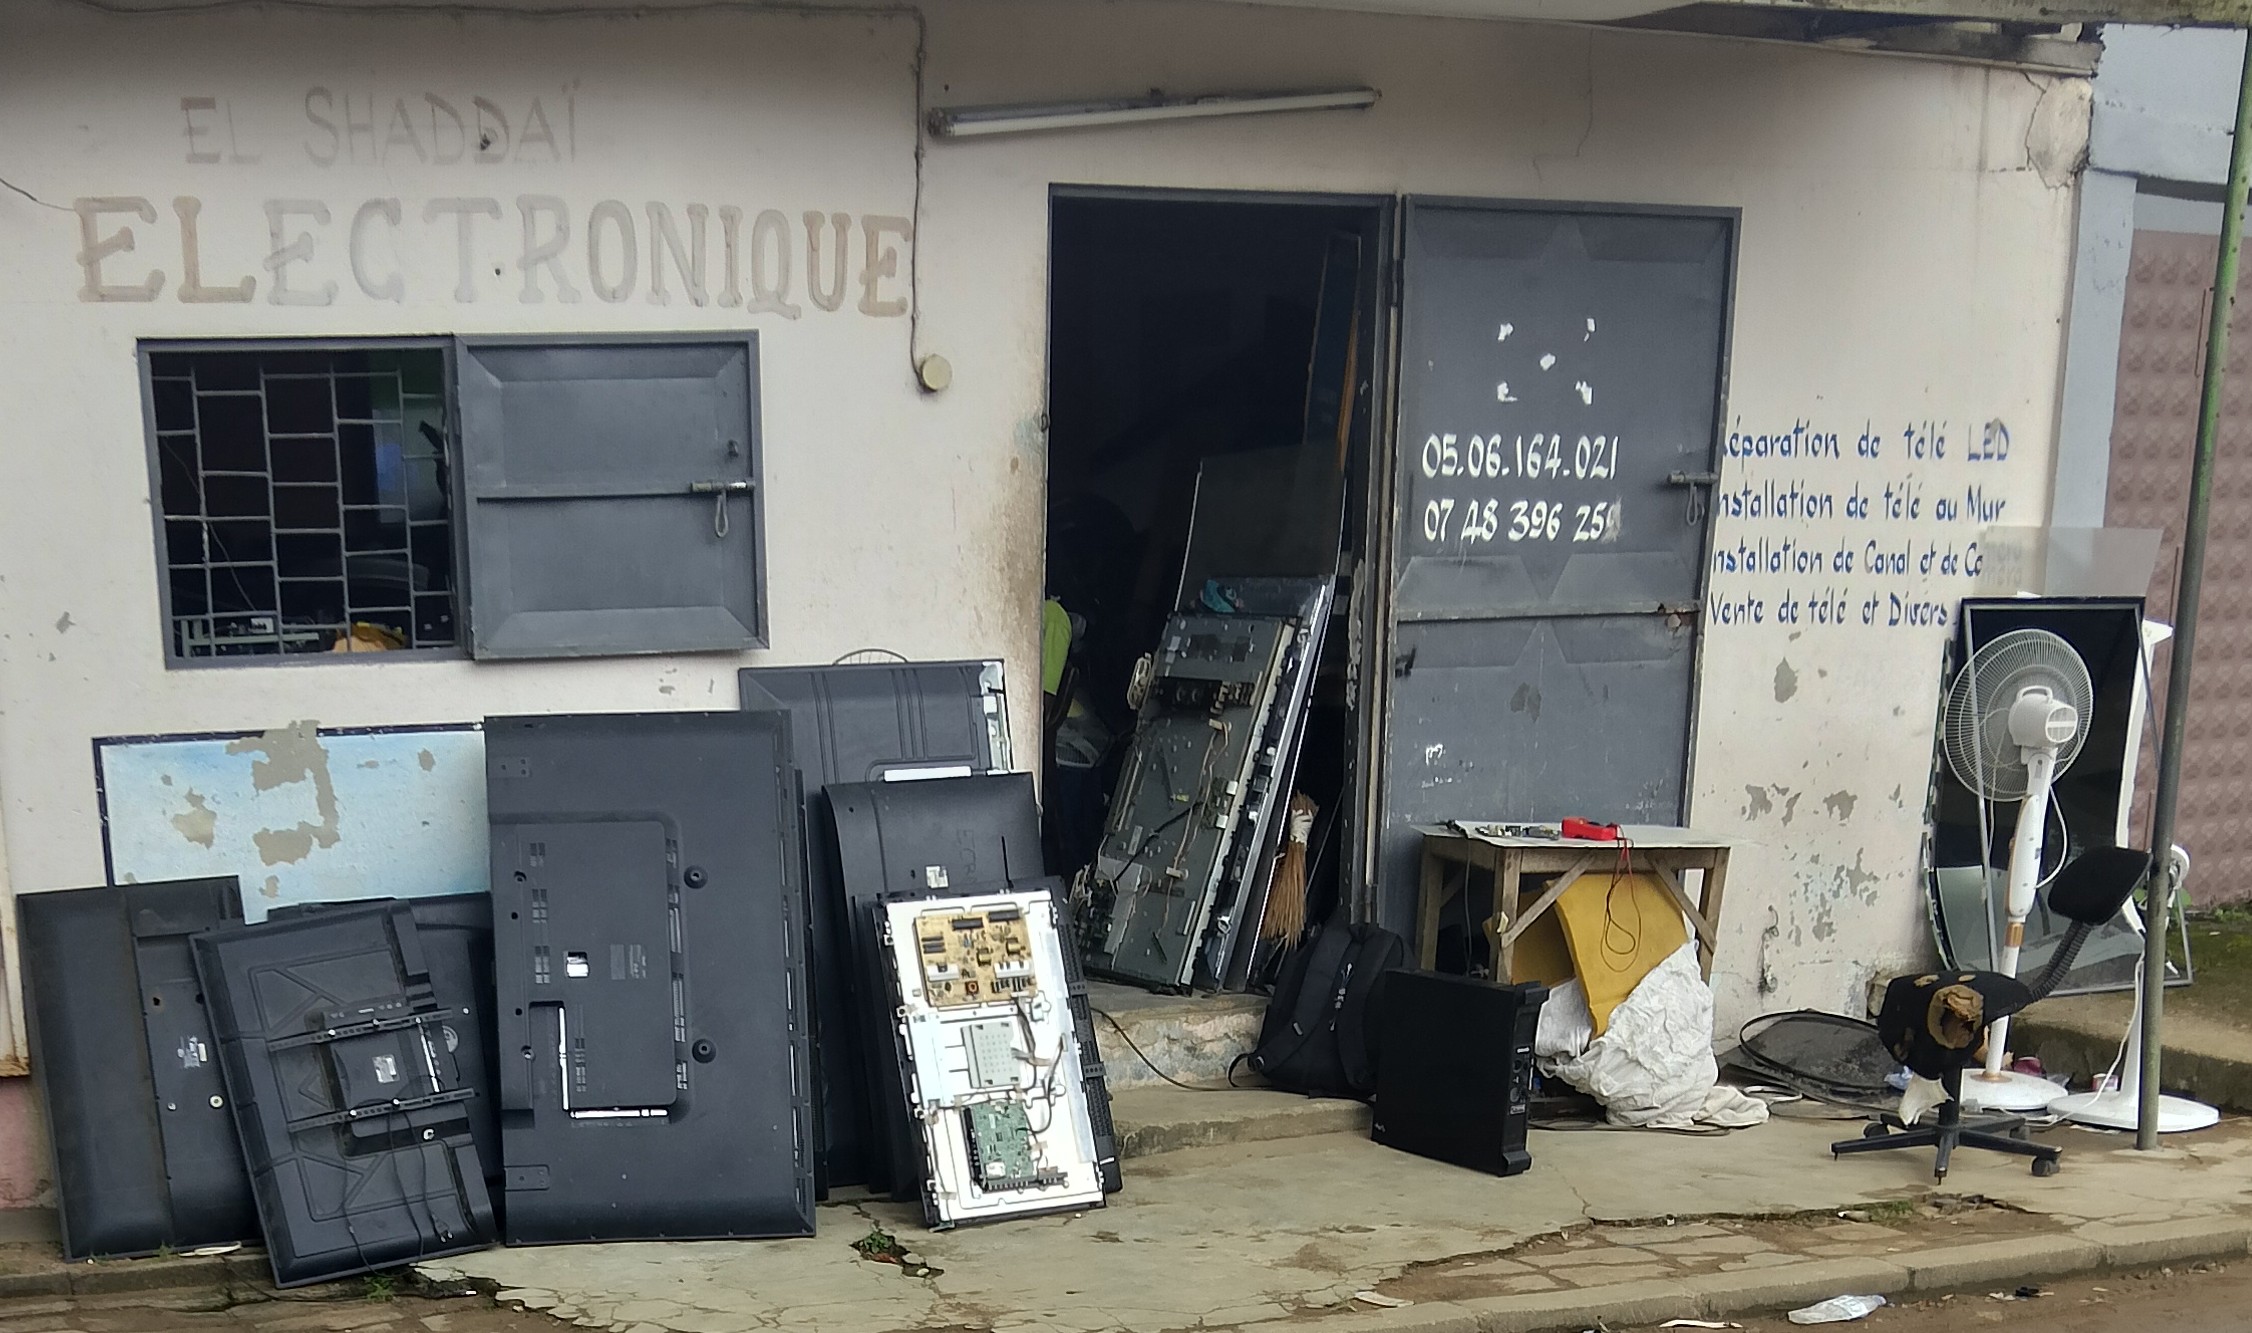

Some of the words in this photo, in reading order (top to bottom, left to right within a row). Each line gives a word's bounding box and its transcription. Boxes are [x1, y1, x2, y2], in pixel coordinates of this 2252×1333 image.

[180, 97, 262, 164] EL
[303, 78, 581, 168] SHADDAÏ
[73, 194, 912, 320] ELECTRONIQUE
[1421, 433, 1620, 480] 05.06.164.021
[1723, 414, 1840, 473] éparation
[1857, 418, 1881, 459] de
[1903, 420, 1947, 459] télé
[1967, 420, 2010, 462] LED
[1424, 499, 1456, 543] 07
[1460, 499, 1500, 544] 48
[1508, 499, 1564, 543] 396
[1718, 479, 1833, 520] nstallation
[1846, 481, 1869, 520] de
[1883, 480, 1923, 520] télé
[1935, 498, 1958, 522] au
[1966, 484, 2006, 524] Mur
[1713, 535, 1822, 574] nstallation
[1833, 536, 1854, 574] de
[1864, 538, 1911, 575] Canal
[1920, 539, 1936, 575] et
[1940, 541, 1958, 576] de
[1710, 590, 1764, 625] Vente
[1777, 587, 1799, 625] de
[1808, 586, 1848, 625] télé
[1862, 590, 1879, 625] et
